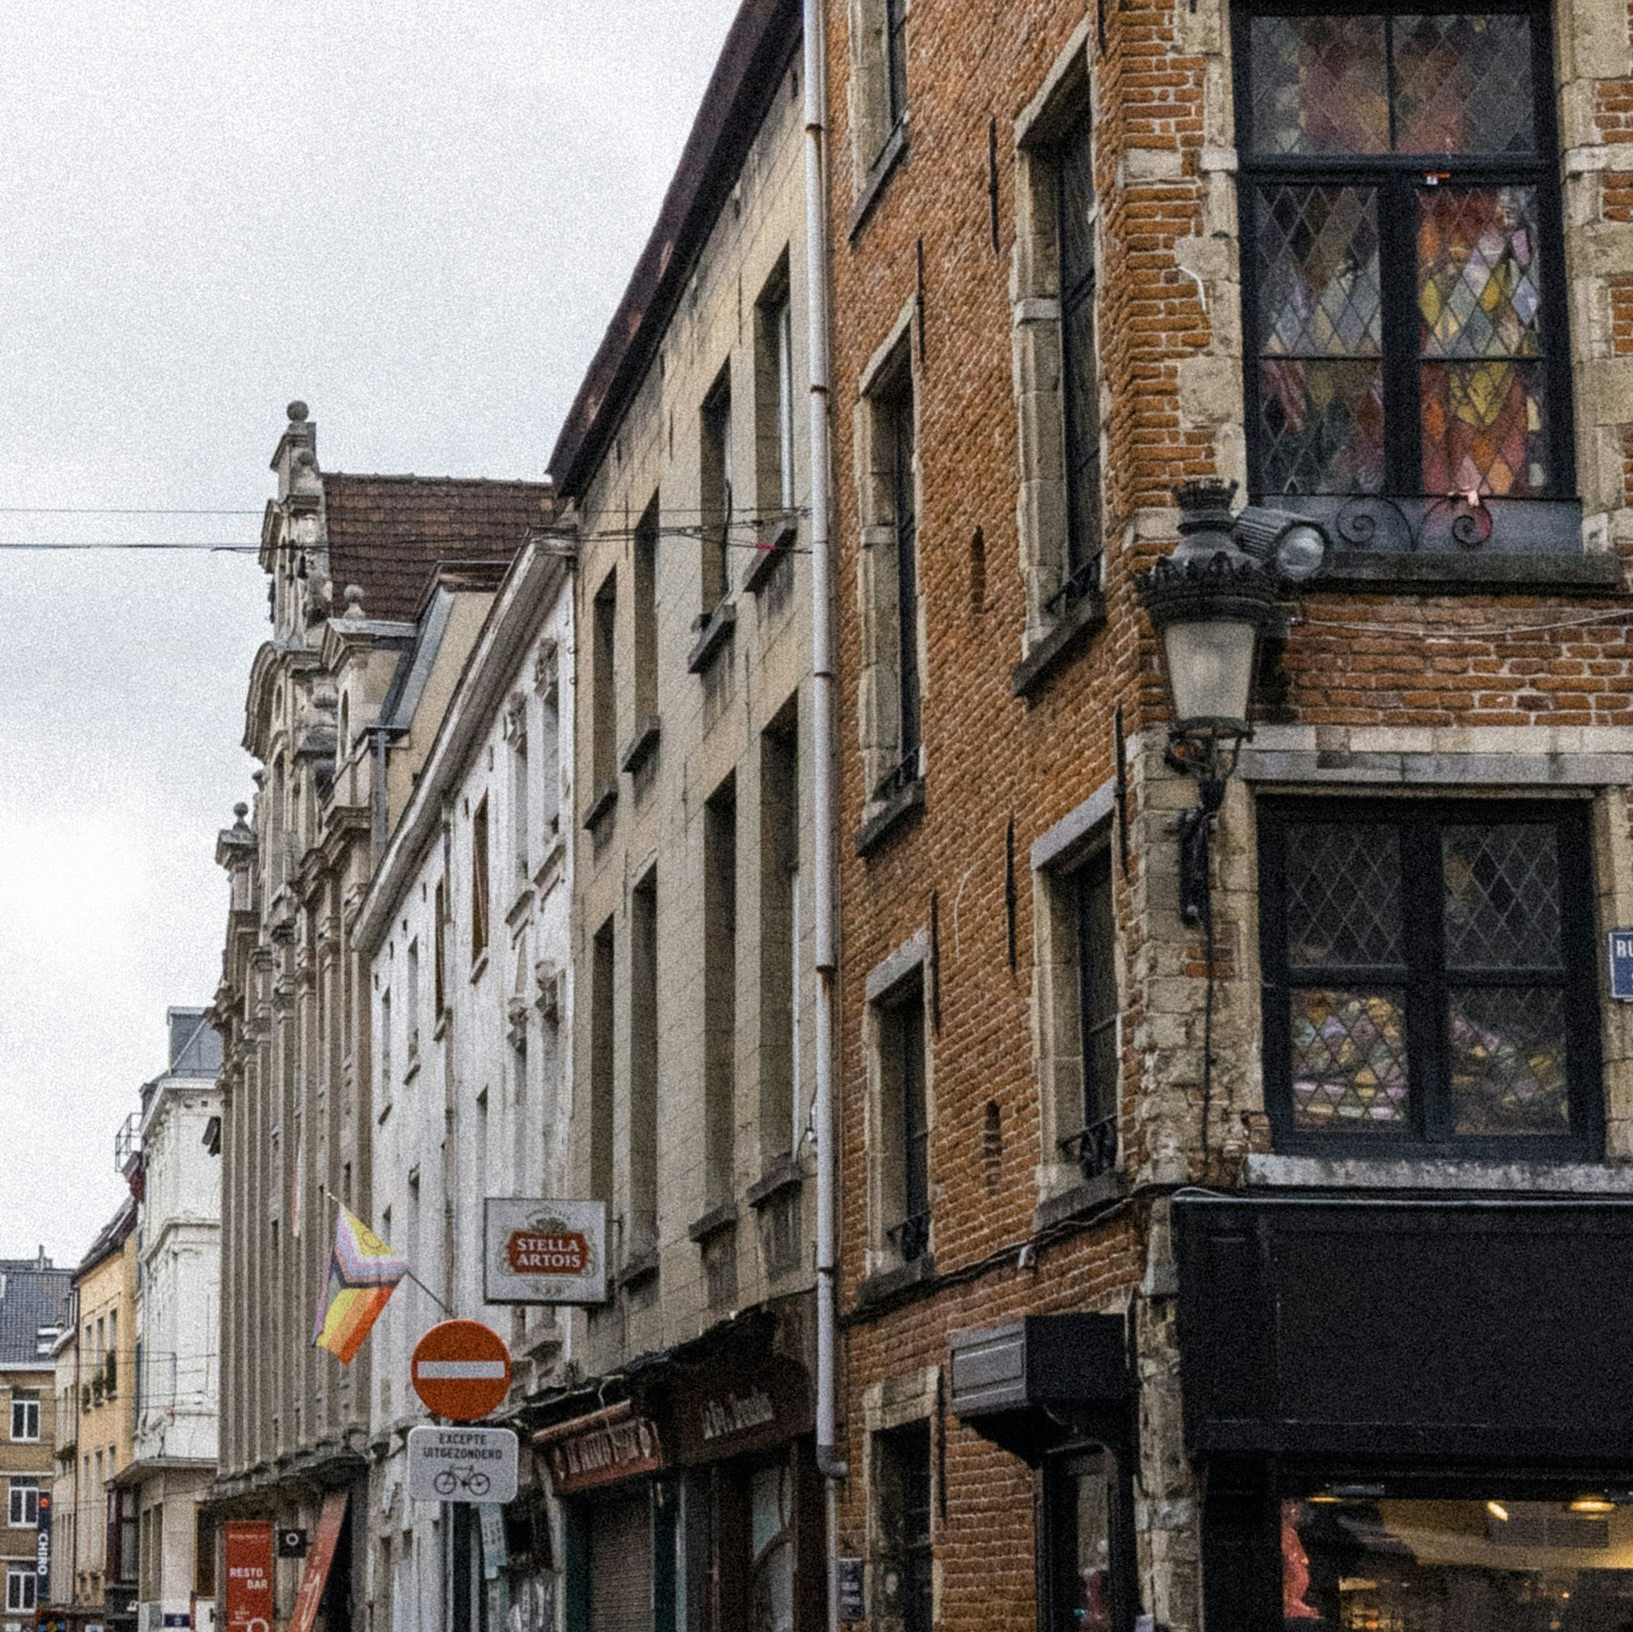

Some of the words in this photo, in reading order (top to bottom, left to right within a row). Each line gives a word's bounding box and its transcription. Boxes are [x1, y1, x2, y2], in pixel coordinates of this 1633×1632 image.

[516, 1238, 581, 1252] STELLA
[517, 1253, 582, 1268] ARTOIS
[423, 1447, 503, 1460] UITGEZONDERD
[229, 1567, 264, 1578] RESTO
[246, 1579, 268, 1590] BAR
